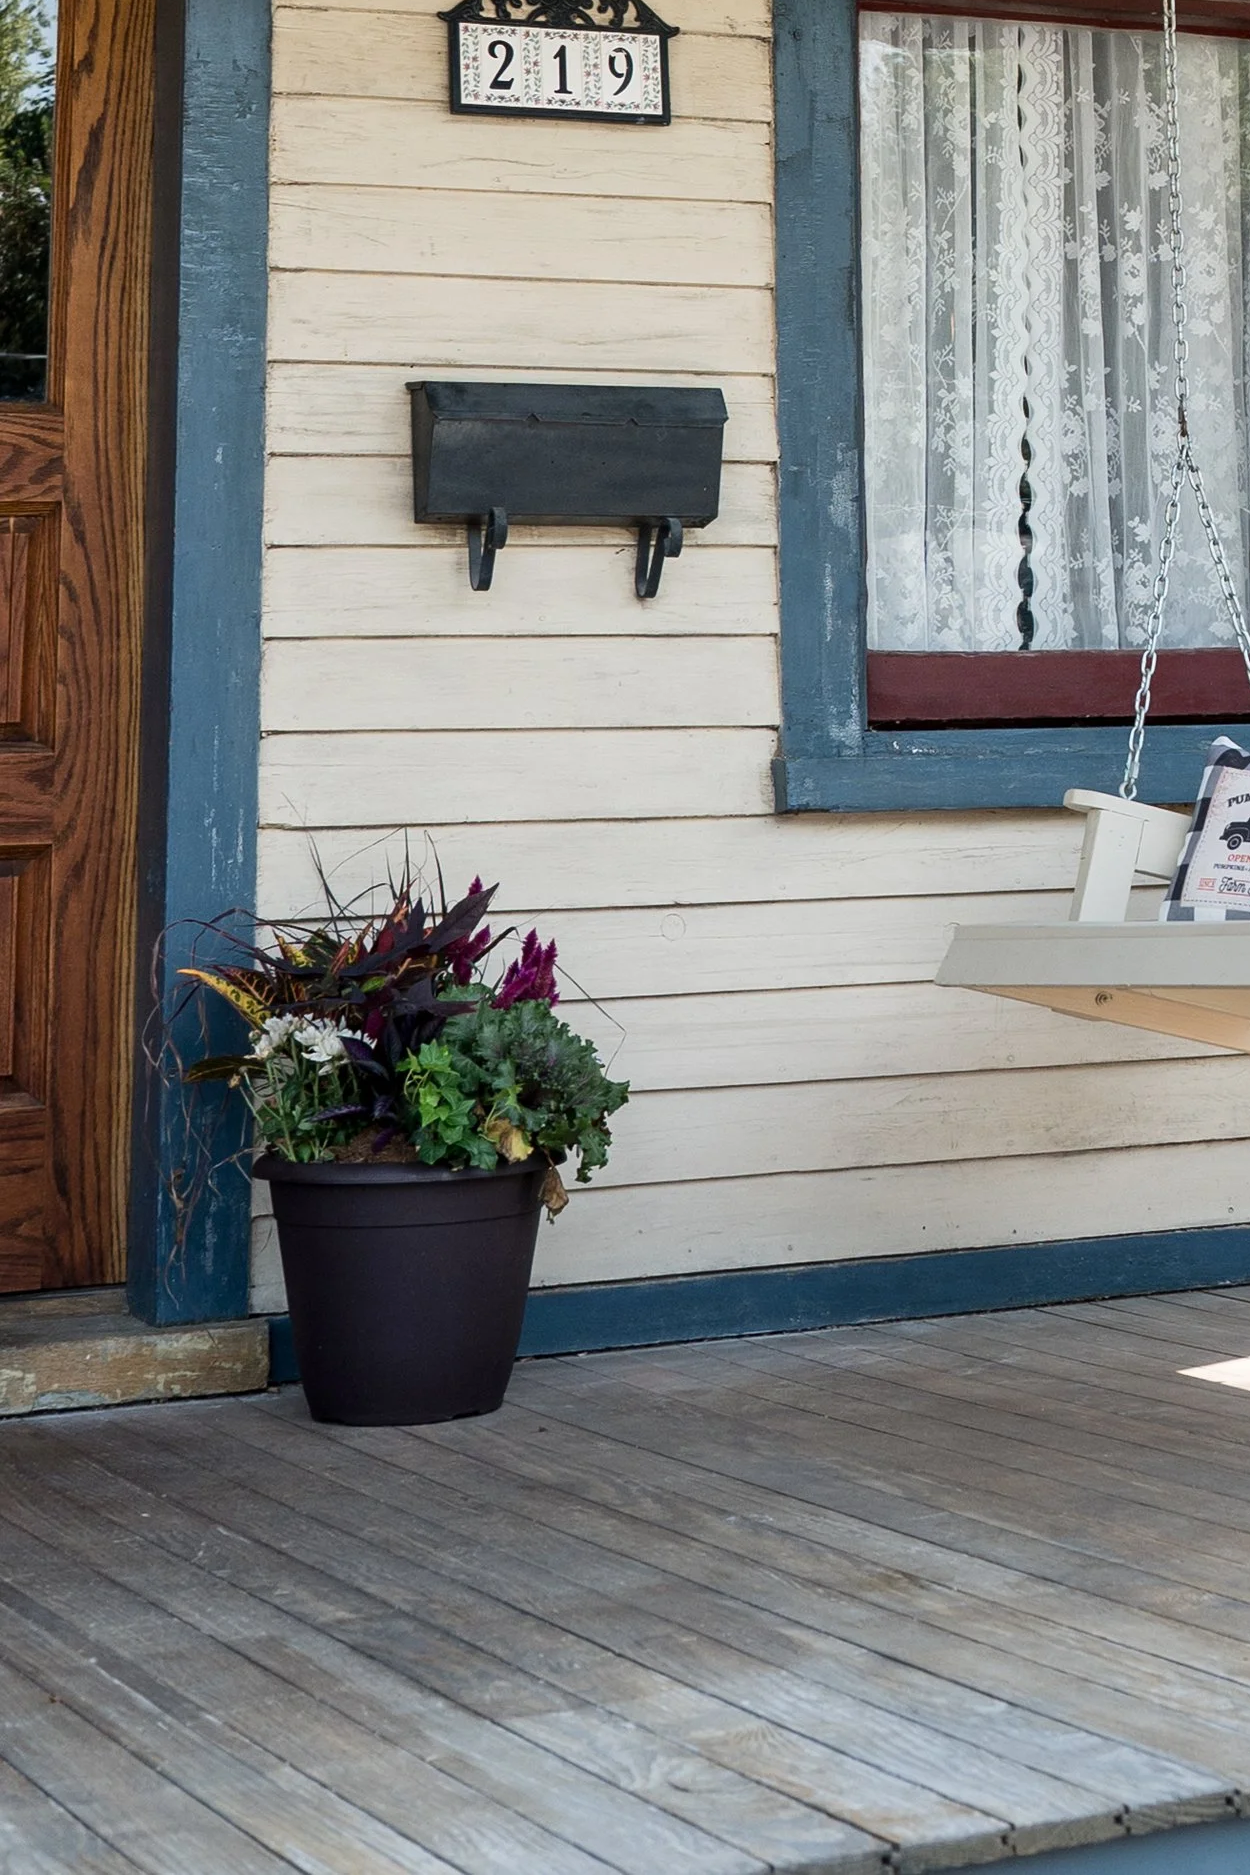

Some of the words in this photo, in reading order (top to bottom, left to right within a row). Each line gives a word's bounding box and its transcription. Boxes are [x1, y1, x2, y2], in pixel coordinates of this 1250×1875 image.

[488, 40, 633, 96] 219
[1213, 863, 1245, 872] PUMPKINS
[1218, 876, 1247, 893] Farm
